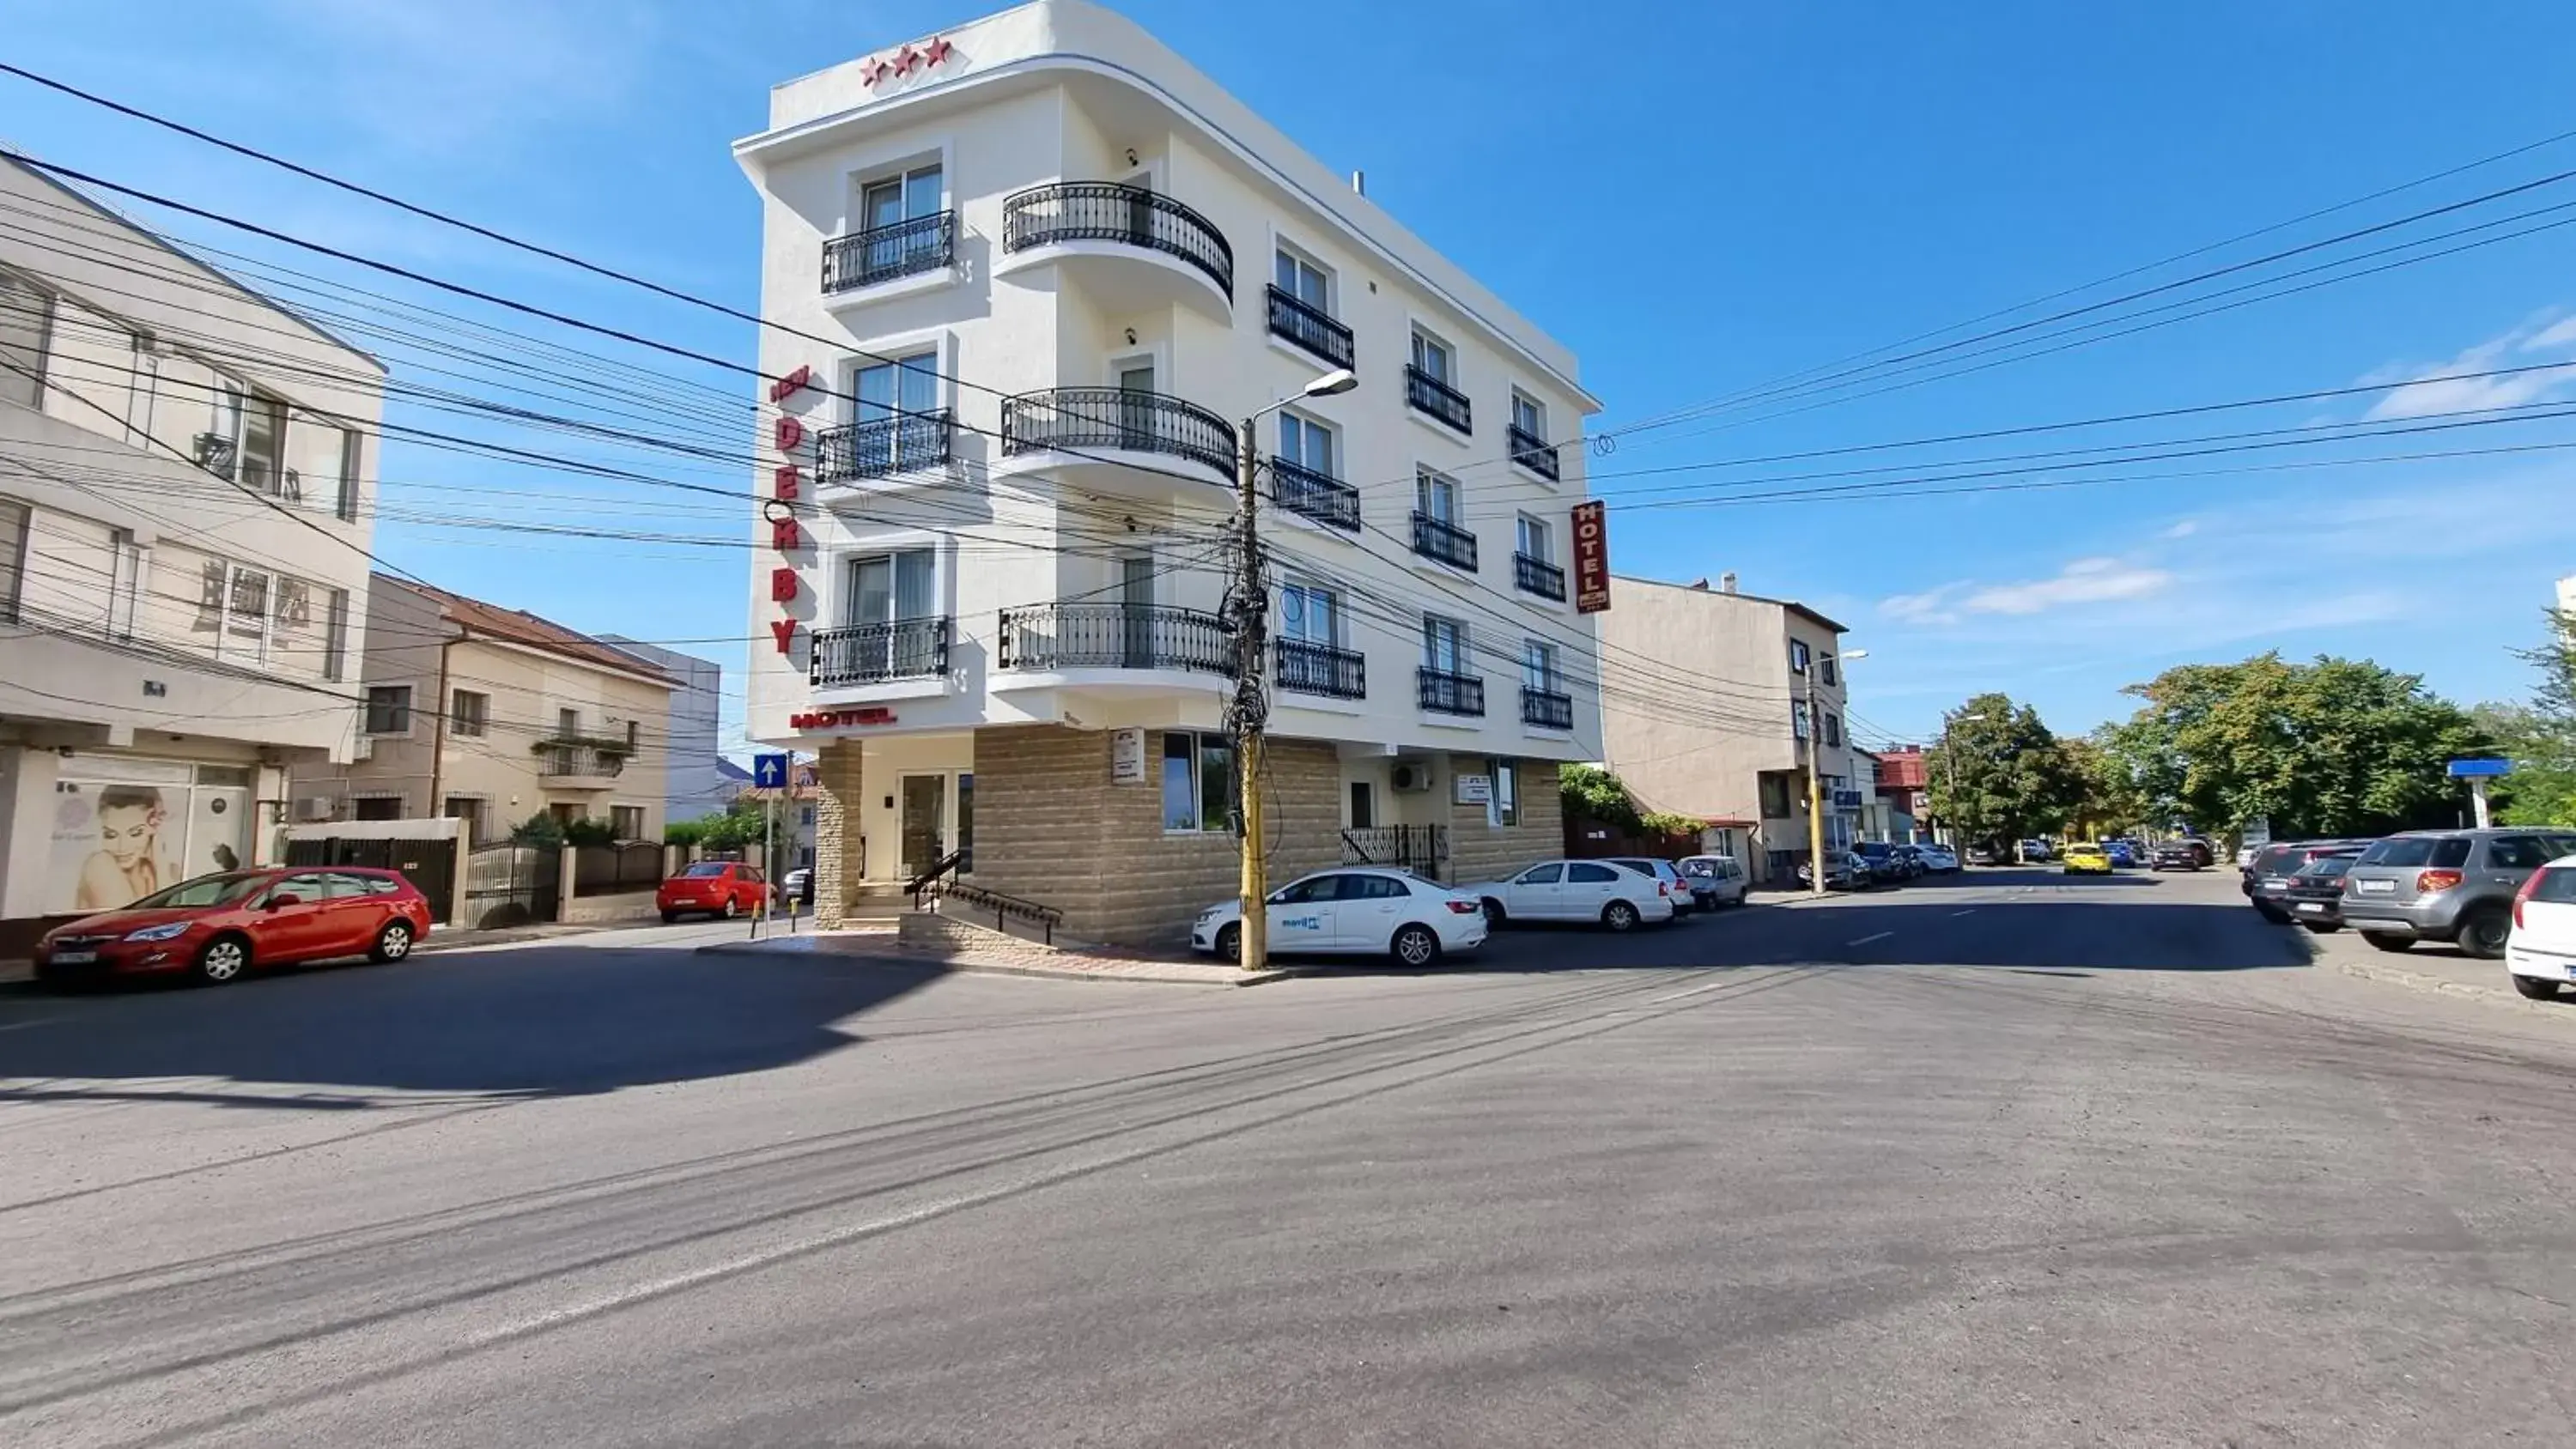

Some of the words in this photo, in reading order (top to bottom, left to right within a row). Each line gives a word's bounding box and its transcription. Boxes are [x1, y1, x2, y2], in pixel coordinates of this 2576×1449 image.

[769, 417, 801, 655] DERBY
[1577, 505, 1600, 591] HOTEL
[789, 706, 899, 729] HOTEL
